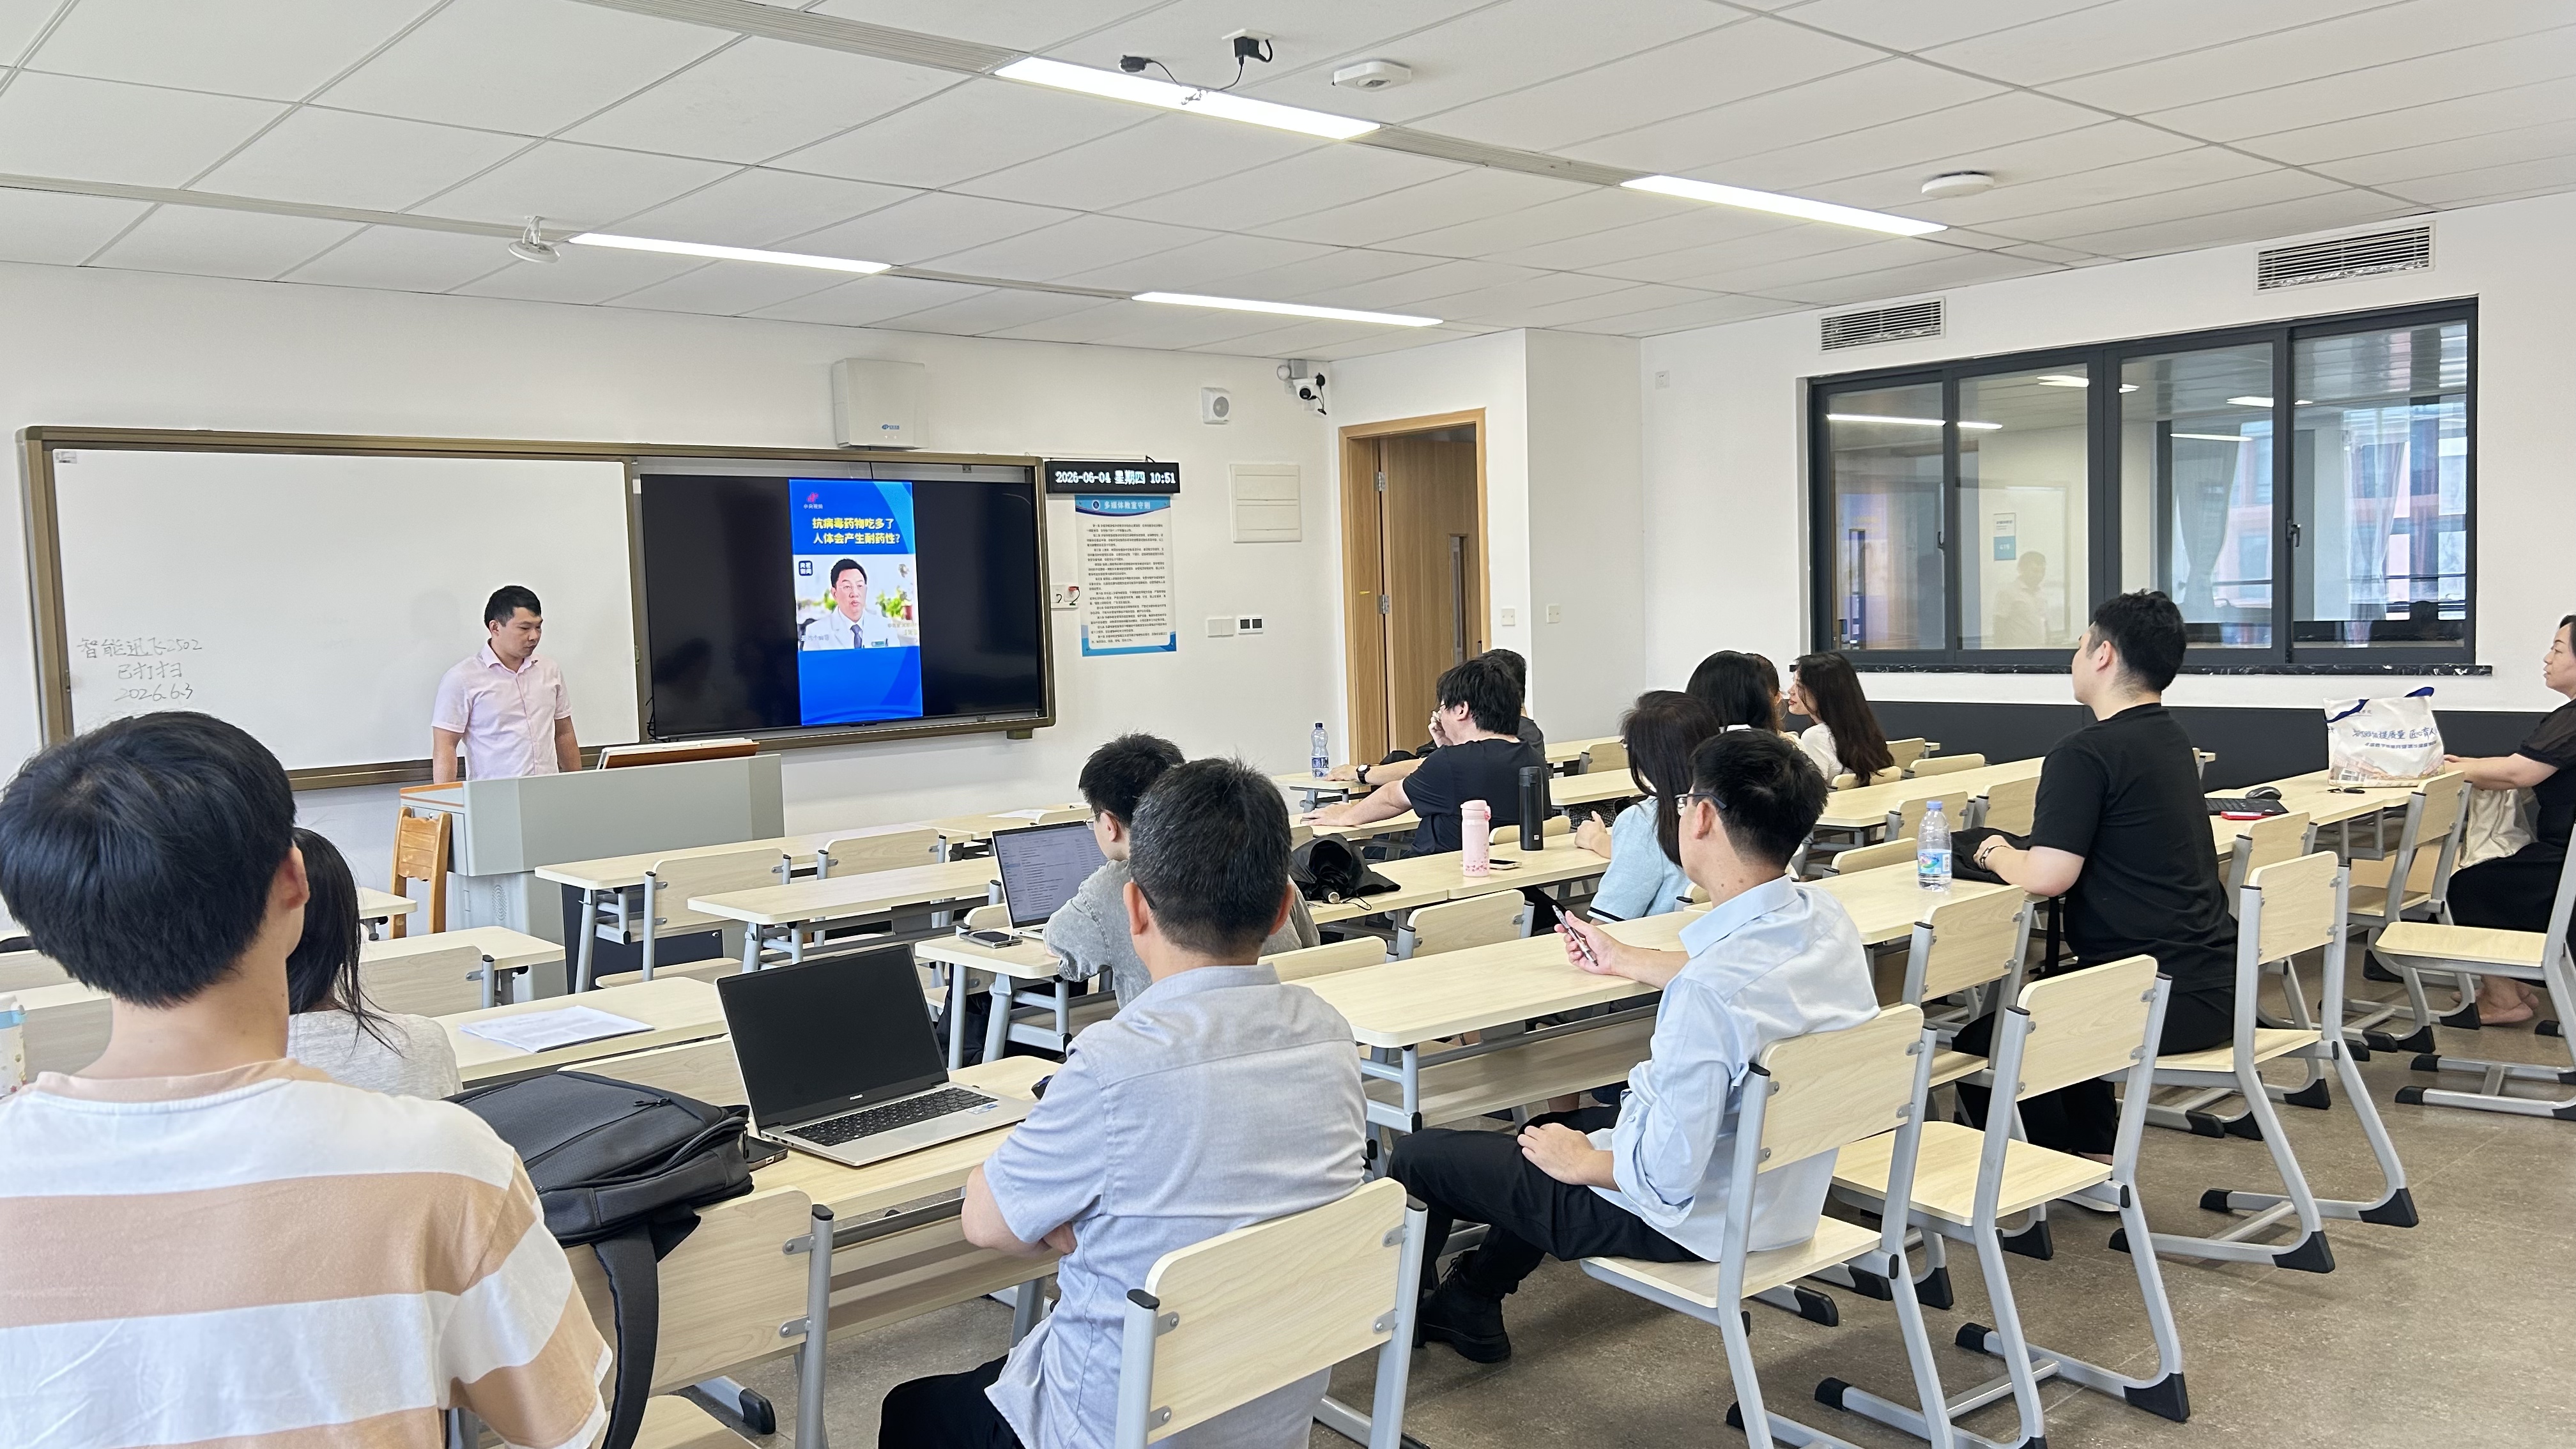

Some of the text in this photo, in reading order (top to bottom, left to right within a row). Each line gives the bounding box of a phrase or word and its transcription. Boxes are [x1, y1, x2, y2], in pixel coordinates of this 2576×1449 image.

[1055, 470, 1176, 485] 2026-06-04 星期四 10:51
[1104, 501, 1151, 510] 多媒体教室守则
[812, 517, 894, 530] 抗病毒药物吃多了
[813, 532, 901, 544] 人体会产生耐药性?
[114, 682, 193, 702] 2026.6.3
